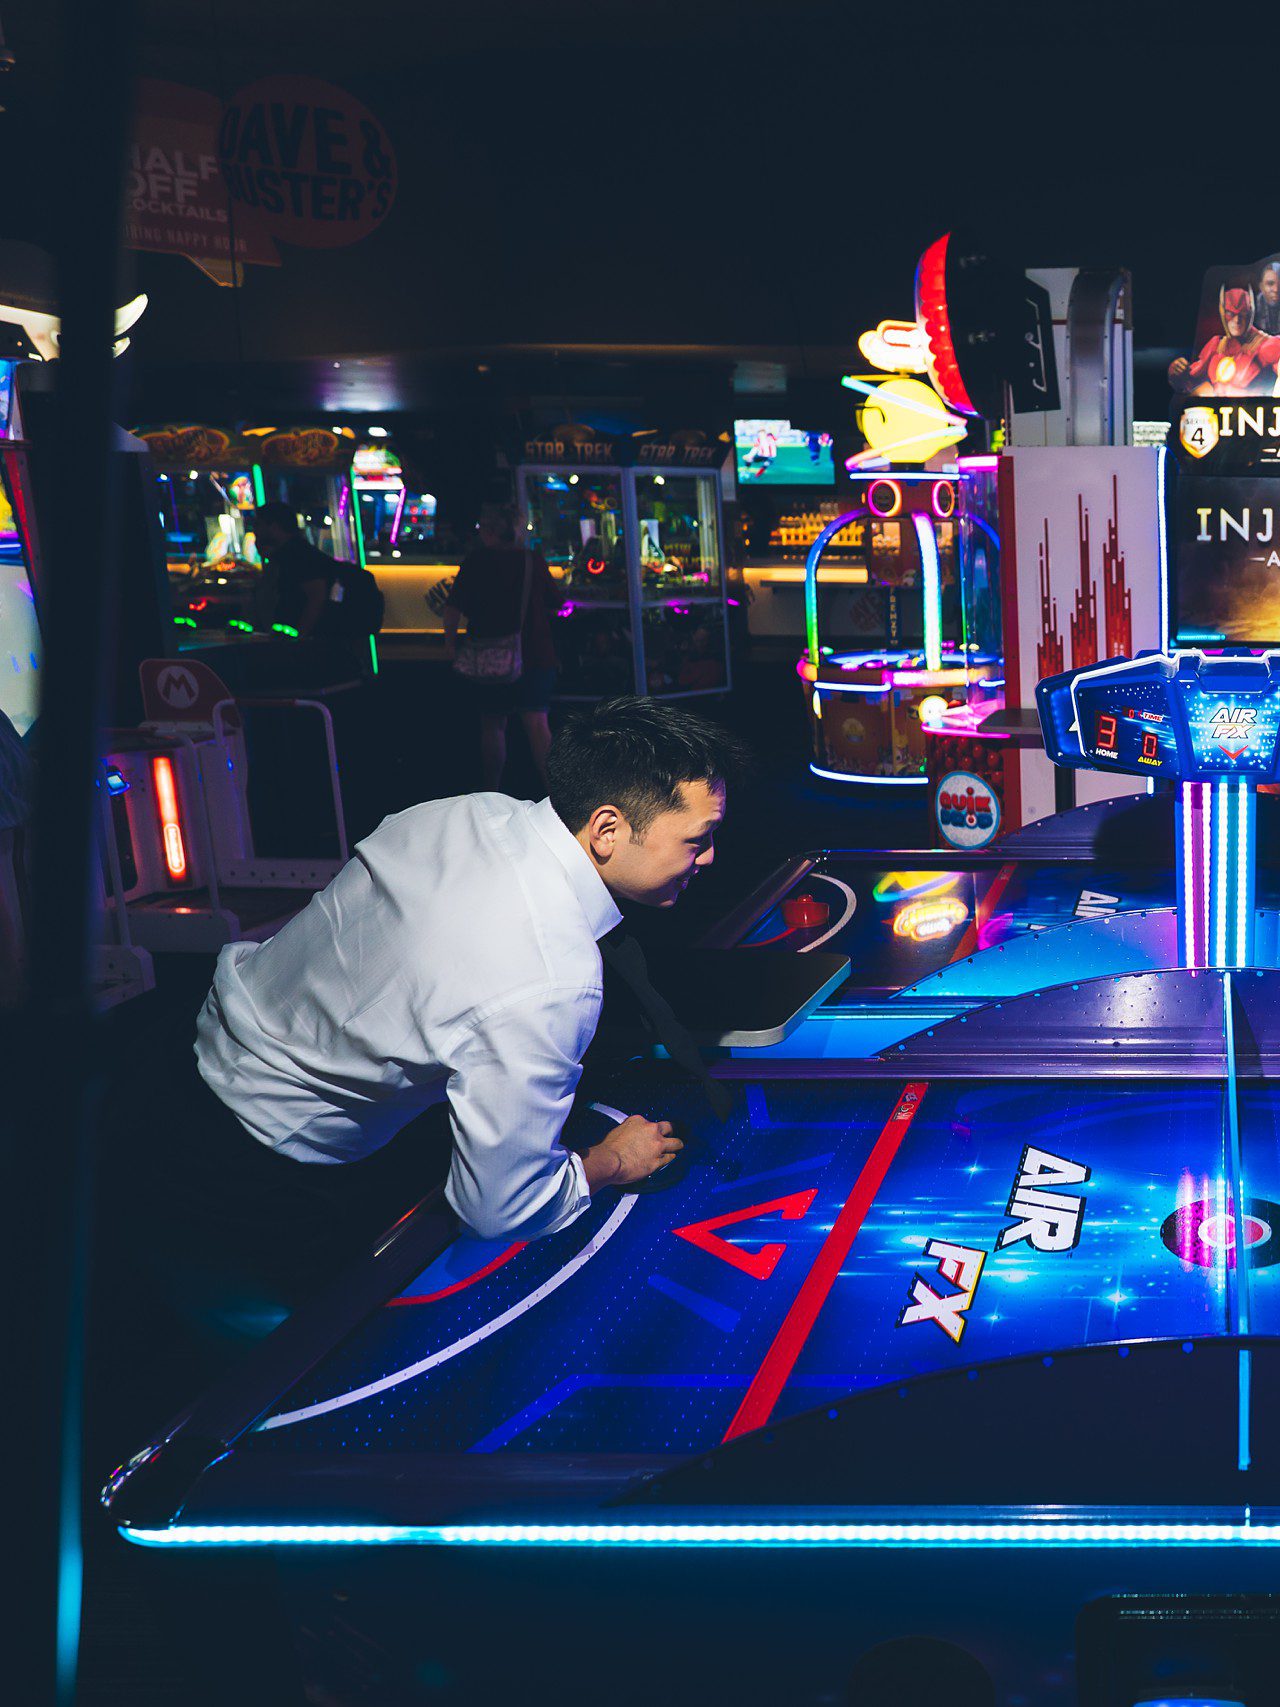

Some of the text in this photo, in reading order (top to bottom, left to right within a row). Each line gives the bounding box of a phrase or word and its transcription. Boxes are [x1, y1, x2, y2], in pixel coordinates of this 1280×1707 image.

[219, 102, 393, 180] DAVE &
[127, 199, 229, 223] OCKTAILS
[1191, 427, 1205, 446] 4
[1143, 711, 1163, 723] TIME
[1209, 707, 1259, 724] AIR
[1098, 715, 1117, 749] 3
[1210, 724, 1256, 740] FX
[1095, 748, 1118, 759] HOME
[1142, 732, 1158, 758] 0
[1137, 756, 1162, 766] AWAY
[994, 1143, 1092, 1253] AIR
[894, 1237, 988, 1347] FX
